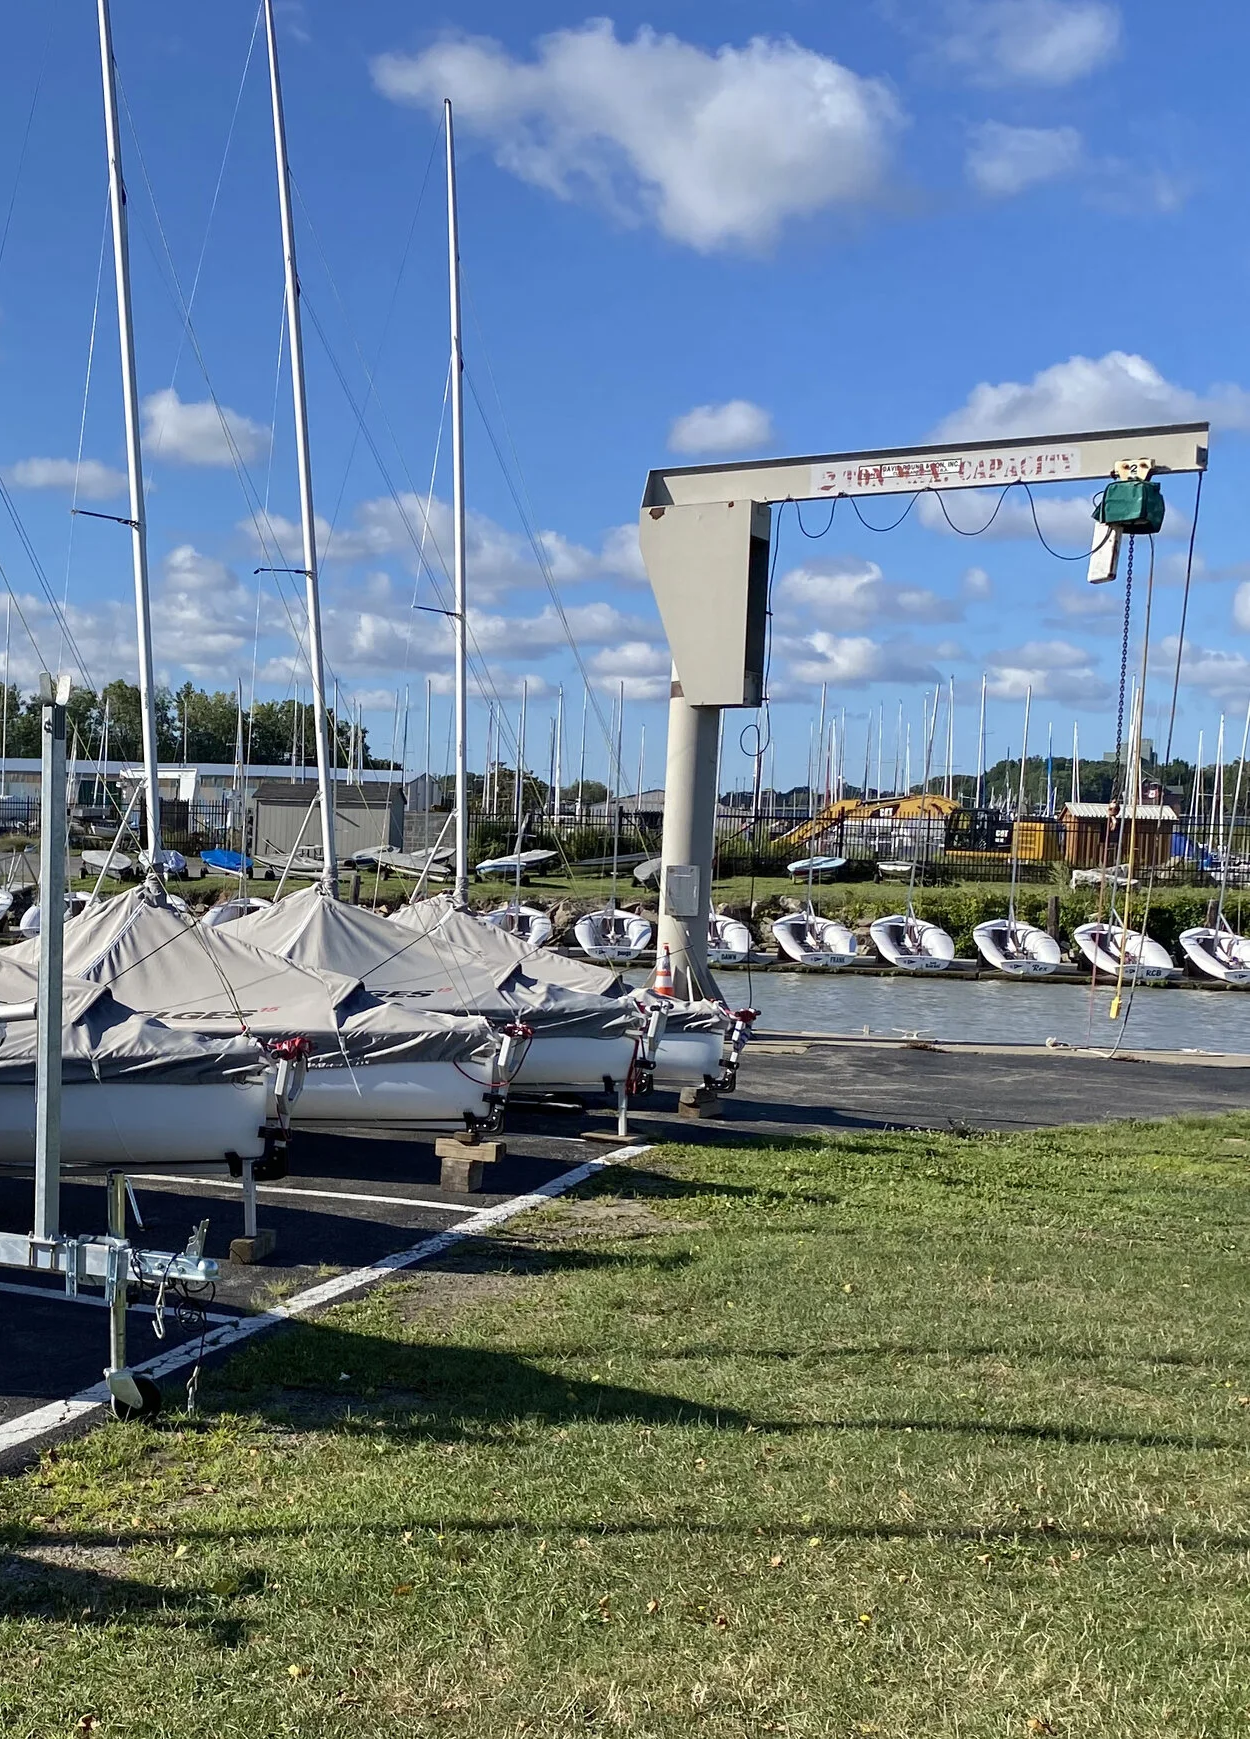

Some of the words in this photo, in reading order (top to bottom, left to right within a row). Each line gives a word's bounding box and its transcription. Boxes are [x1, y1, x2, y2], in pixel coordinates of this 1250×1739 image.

[930, 461, 946, 470] ON,
[1130, 464, 1138, 473] 2
[879, 808, 893, 817] CAT
[995, 829, 1009, 837] CAT
[1031, 964, 1048, 972] Rex
